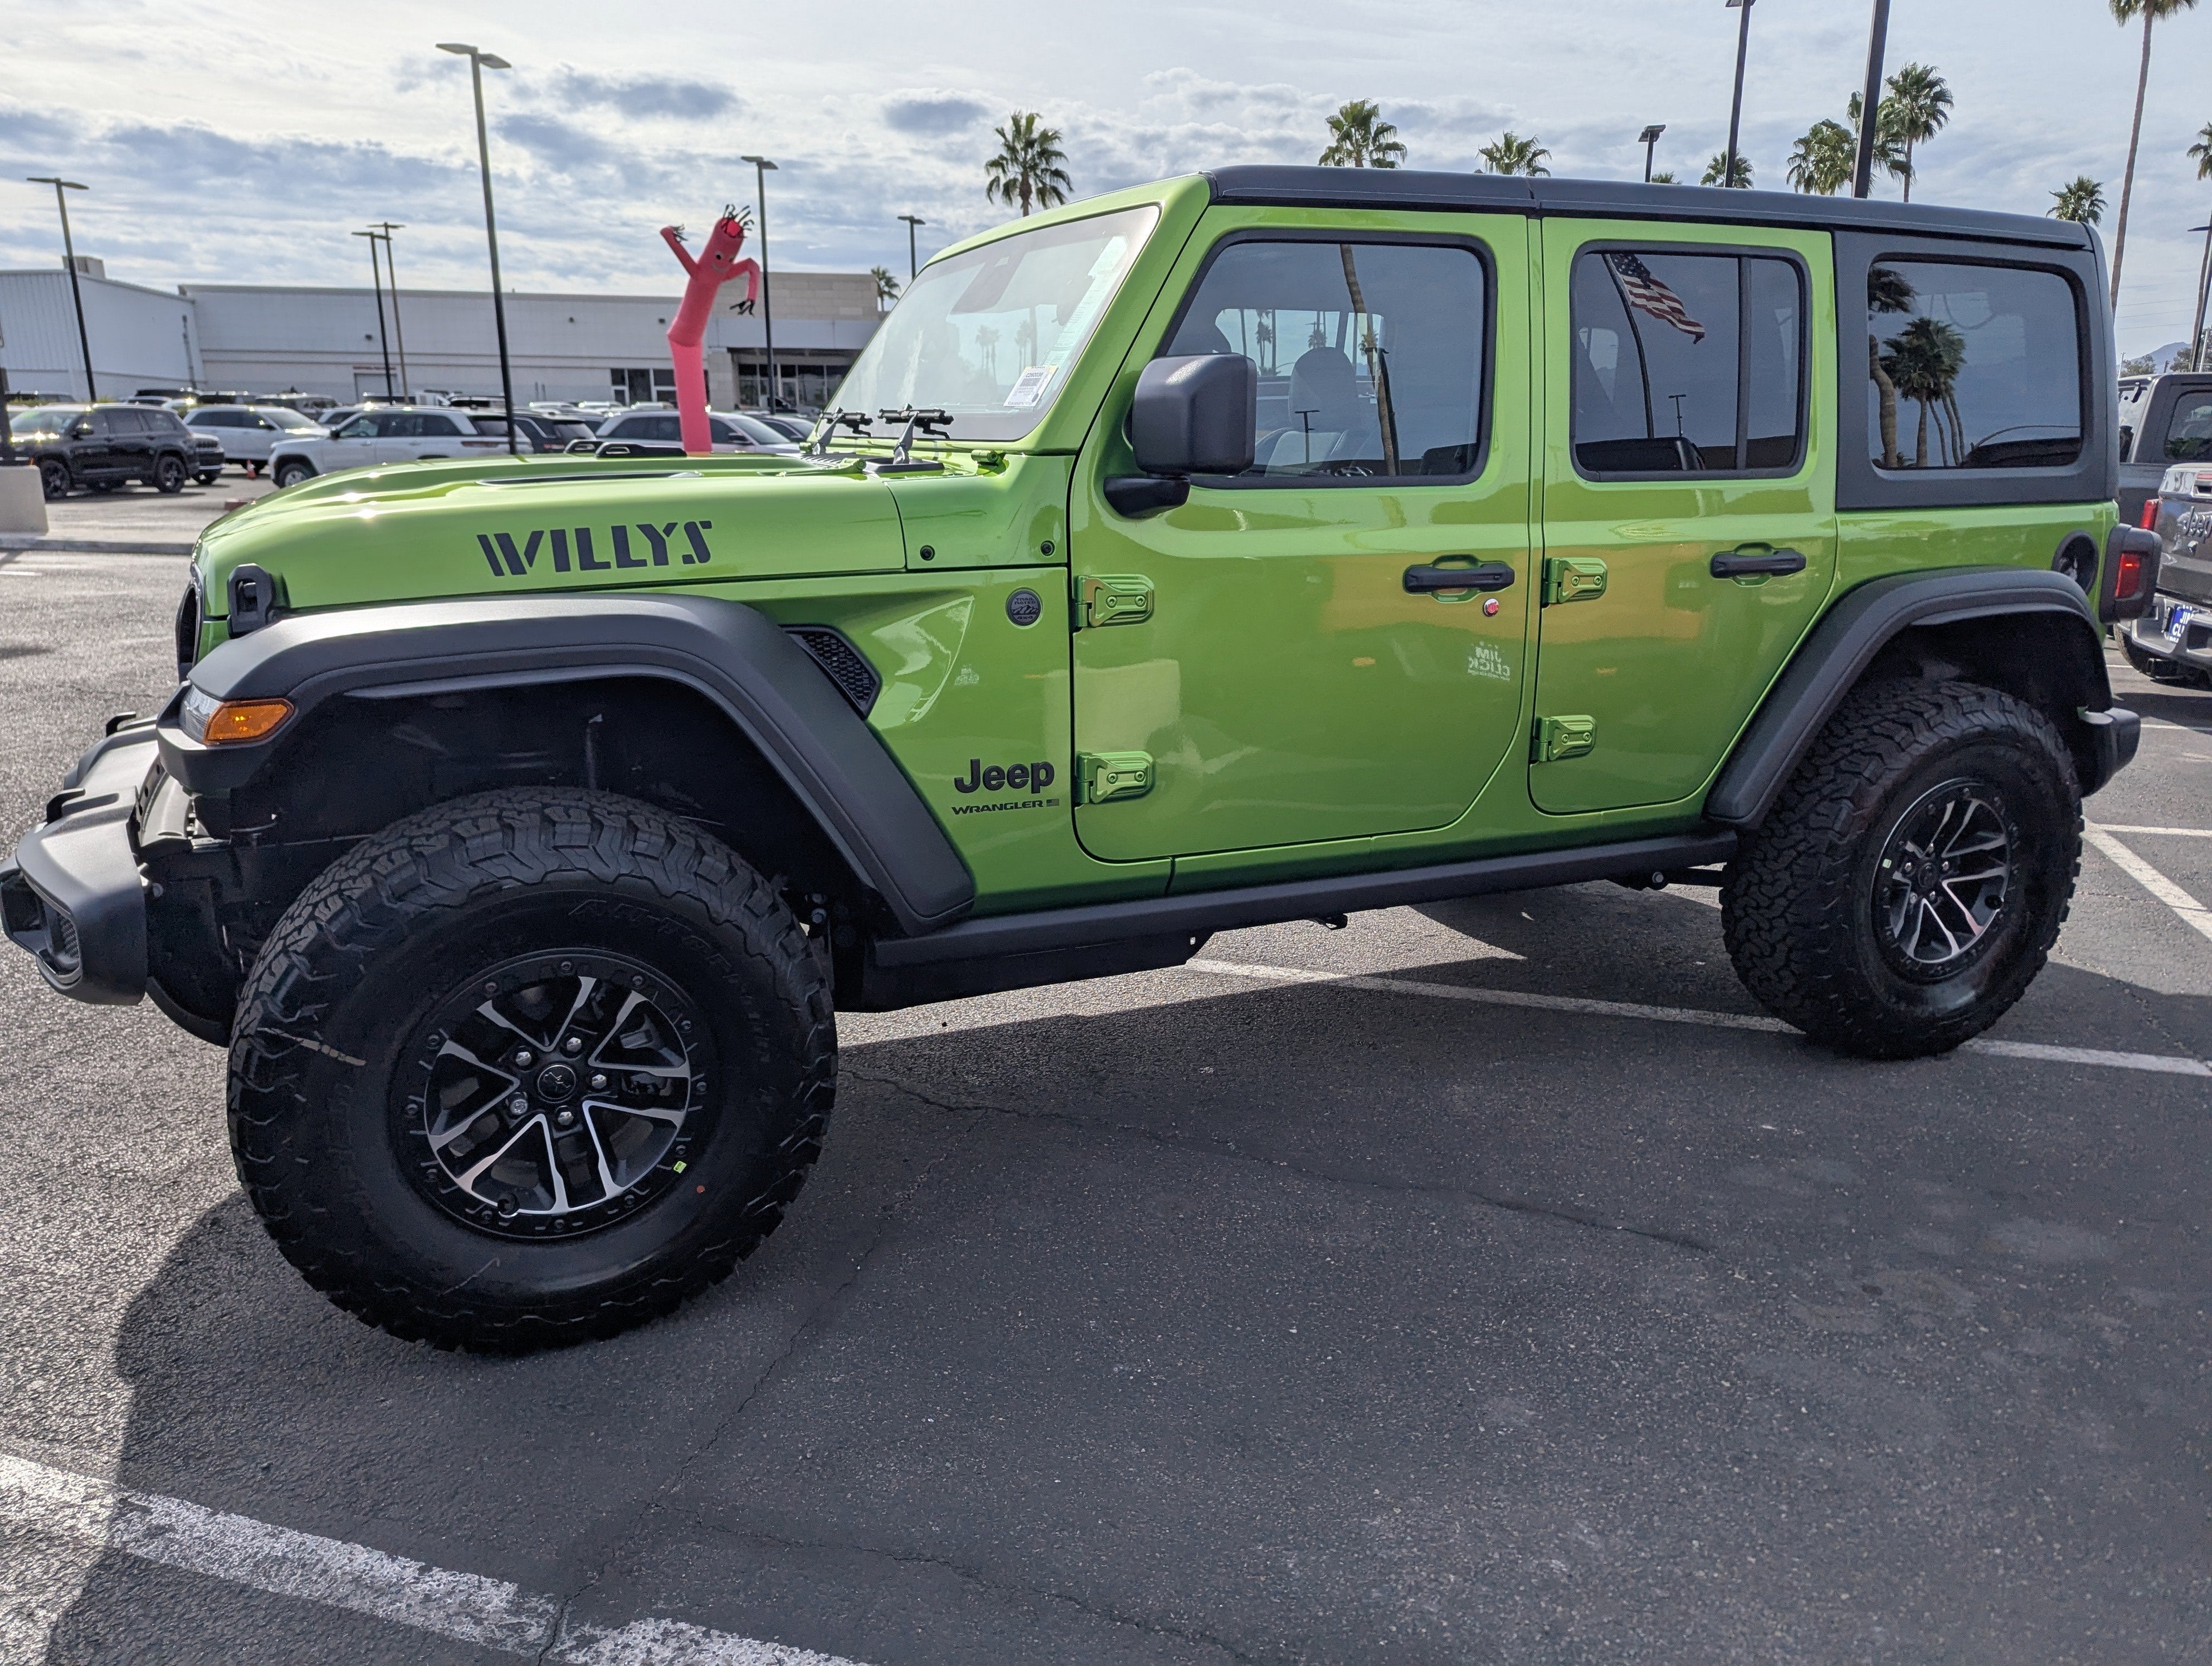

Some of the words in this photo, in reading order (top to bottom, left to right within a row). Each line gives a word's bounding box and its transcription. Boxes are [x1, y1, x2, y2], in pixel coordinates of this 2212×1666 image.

[477, 521, 712, 576] WILLYS
[954, 758, 1055, 794] Jeep
[951, 800, 1044, 815] WRANGLER
